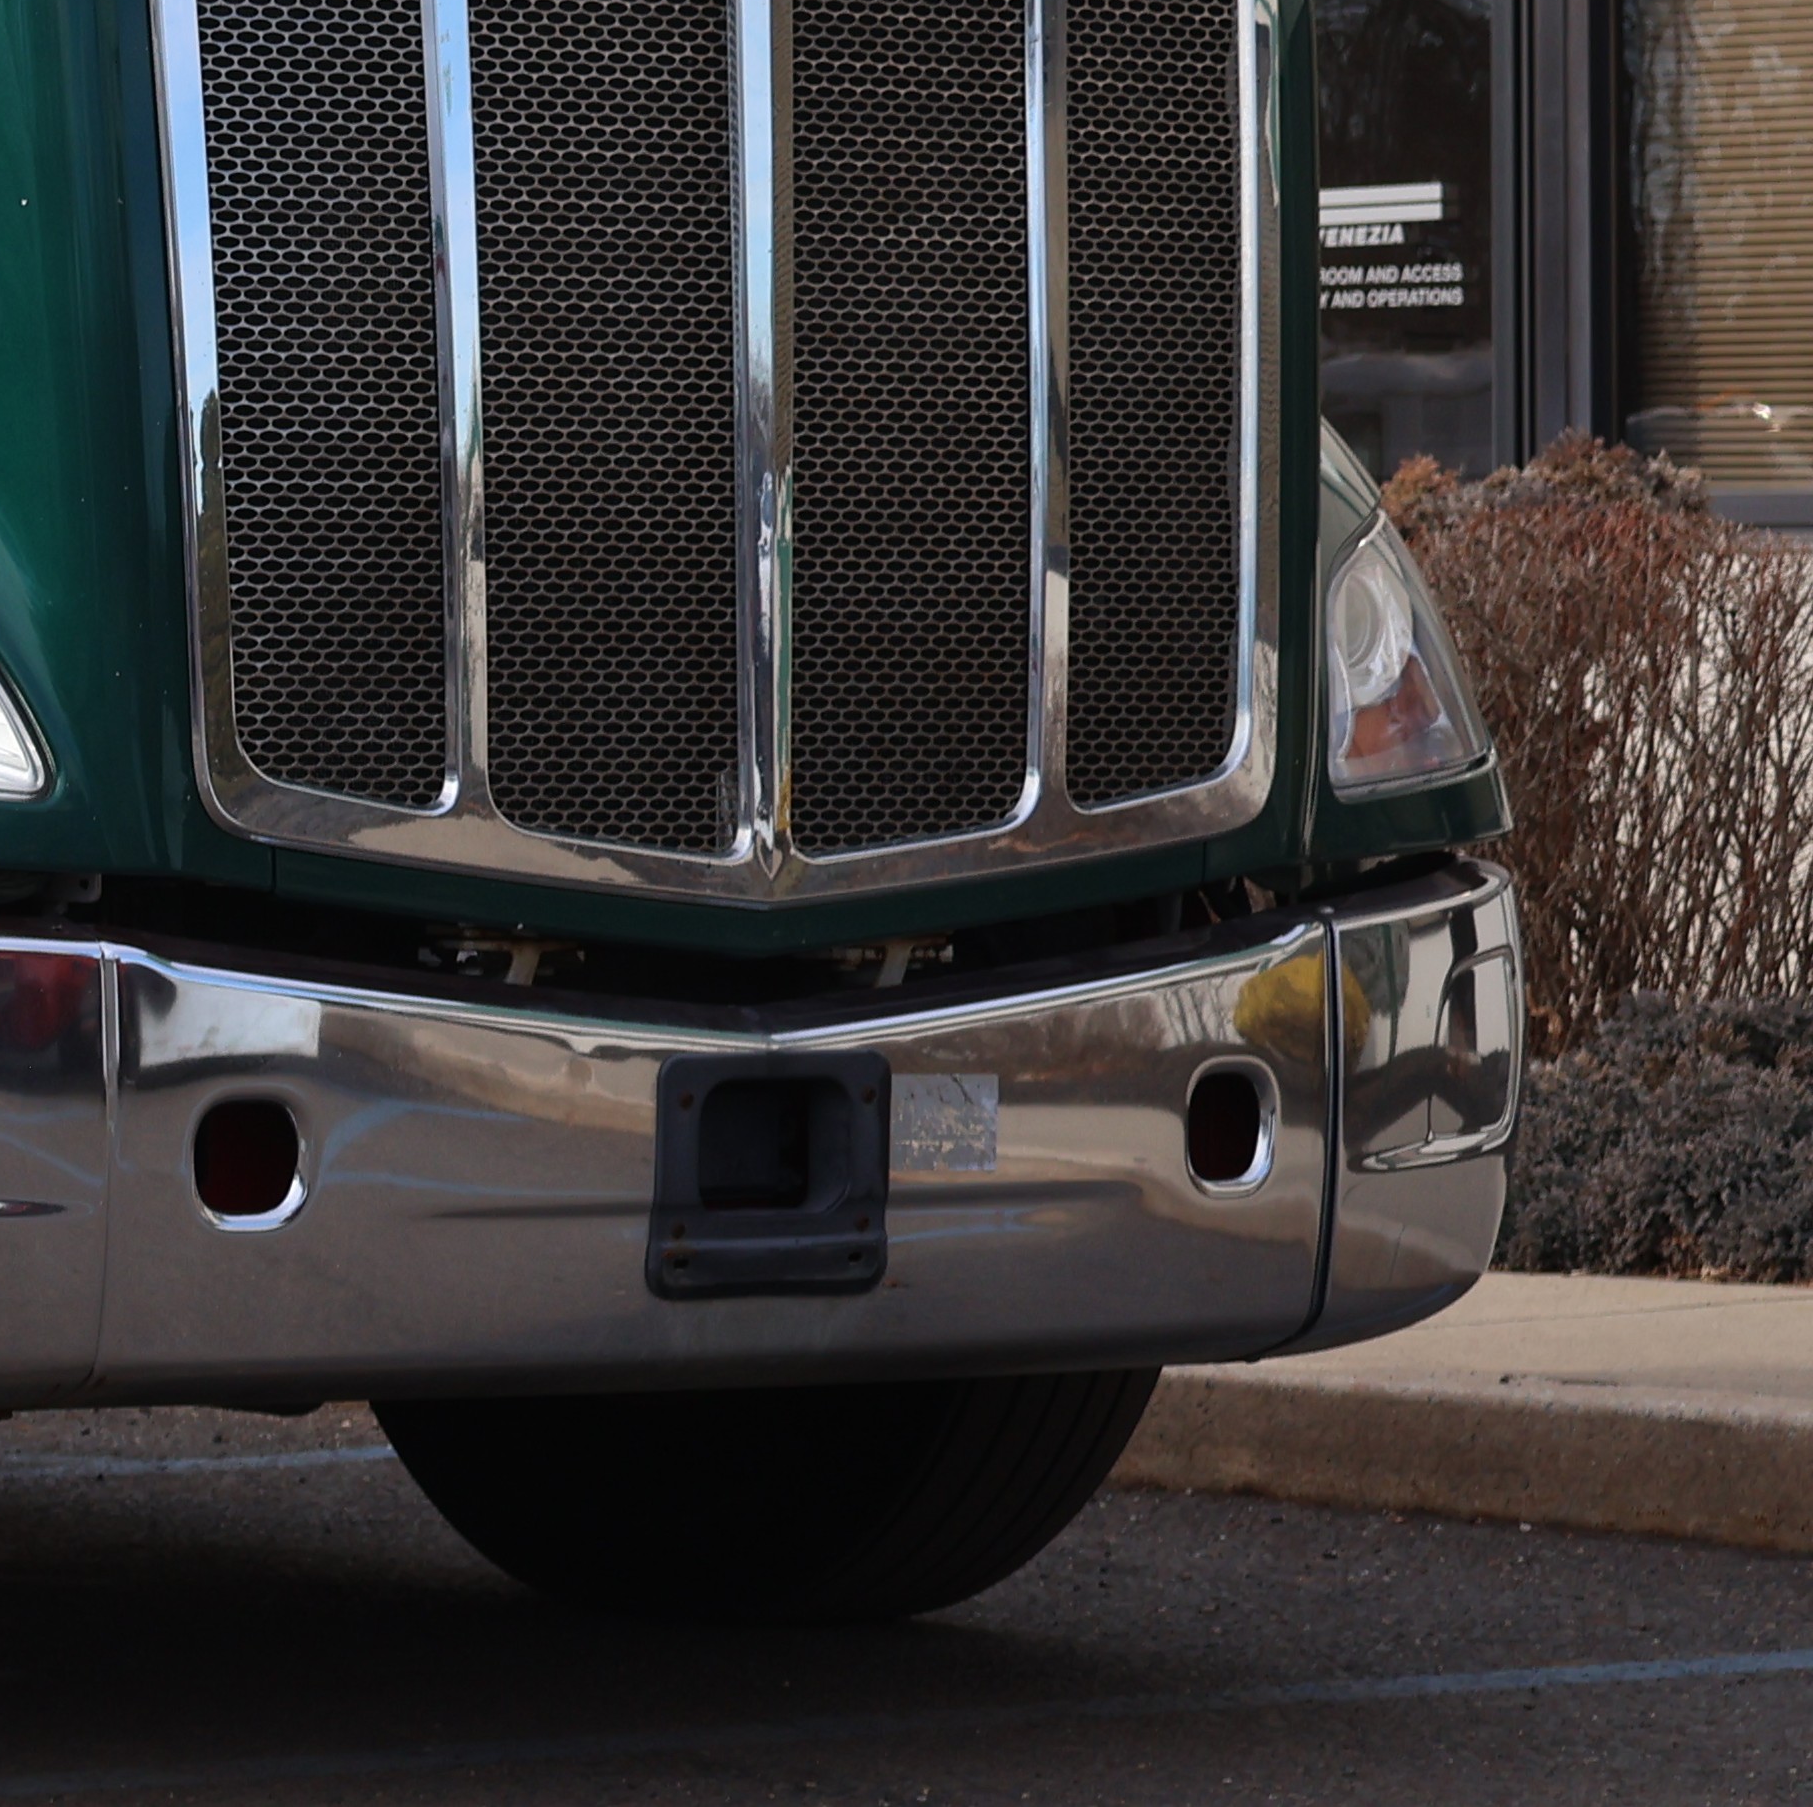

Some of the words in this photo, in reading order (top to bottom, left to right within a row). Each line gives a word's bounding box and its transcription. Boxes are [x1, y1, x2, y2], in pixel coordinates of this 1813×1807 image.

[1365, 263, 1399, 284] AND
[1400, 262, 1464, 283] ACCESS
[1331, 289, 1365, 309] AND
[1366, 286, 1464, 307] OPERATIONS
